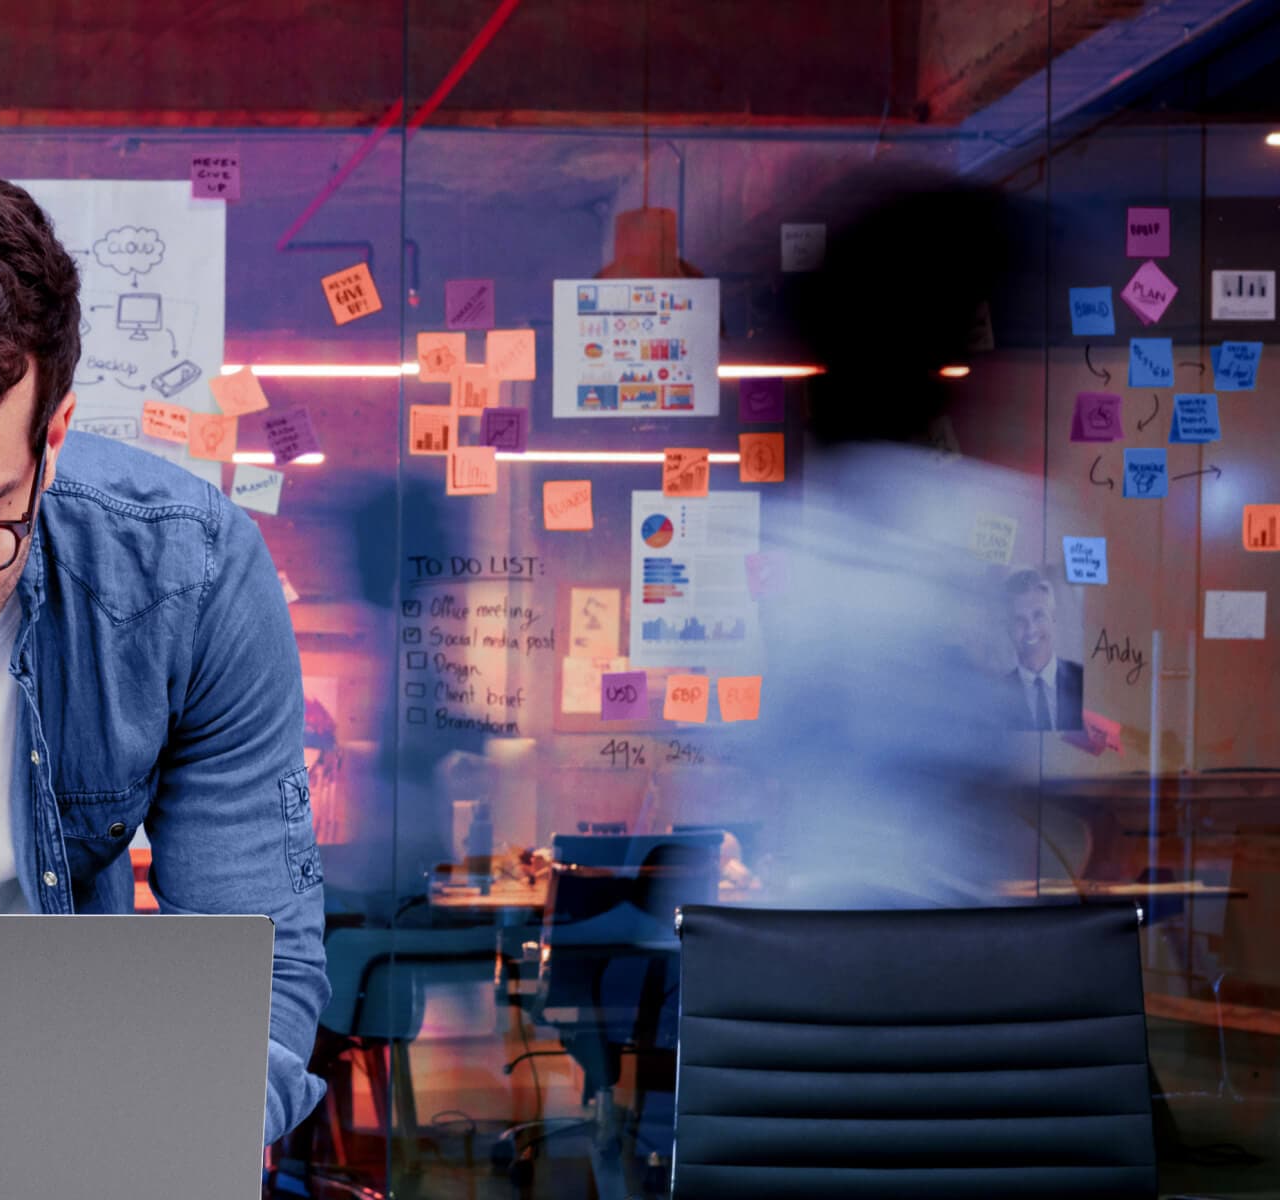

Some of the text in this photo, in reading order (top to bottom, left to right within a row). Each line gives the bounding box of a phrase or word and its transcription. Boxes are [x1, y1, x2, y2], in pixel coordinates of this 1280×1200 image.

[107, 241, 155, 255] CLOUD
[1132, 281, 1166, 302] PLAN
[408, 555, 545, 577] TO DO LIST:
[429, 595, 541, 630] Office meeting
[429, 626, 478, 648] Social
[526, 628, 556, 656] post
[1091, 629, 1147, 685] Andy
[434, 681, 476, 705] Client
[605, 684, 638, 704] USD
[435, 708, 520, 734] Brainstorm
[600, 739, 646, 771] 49%
